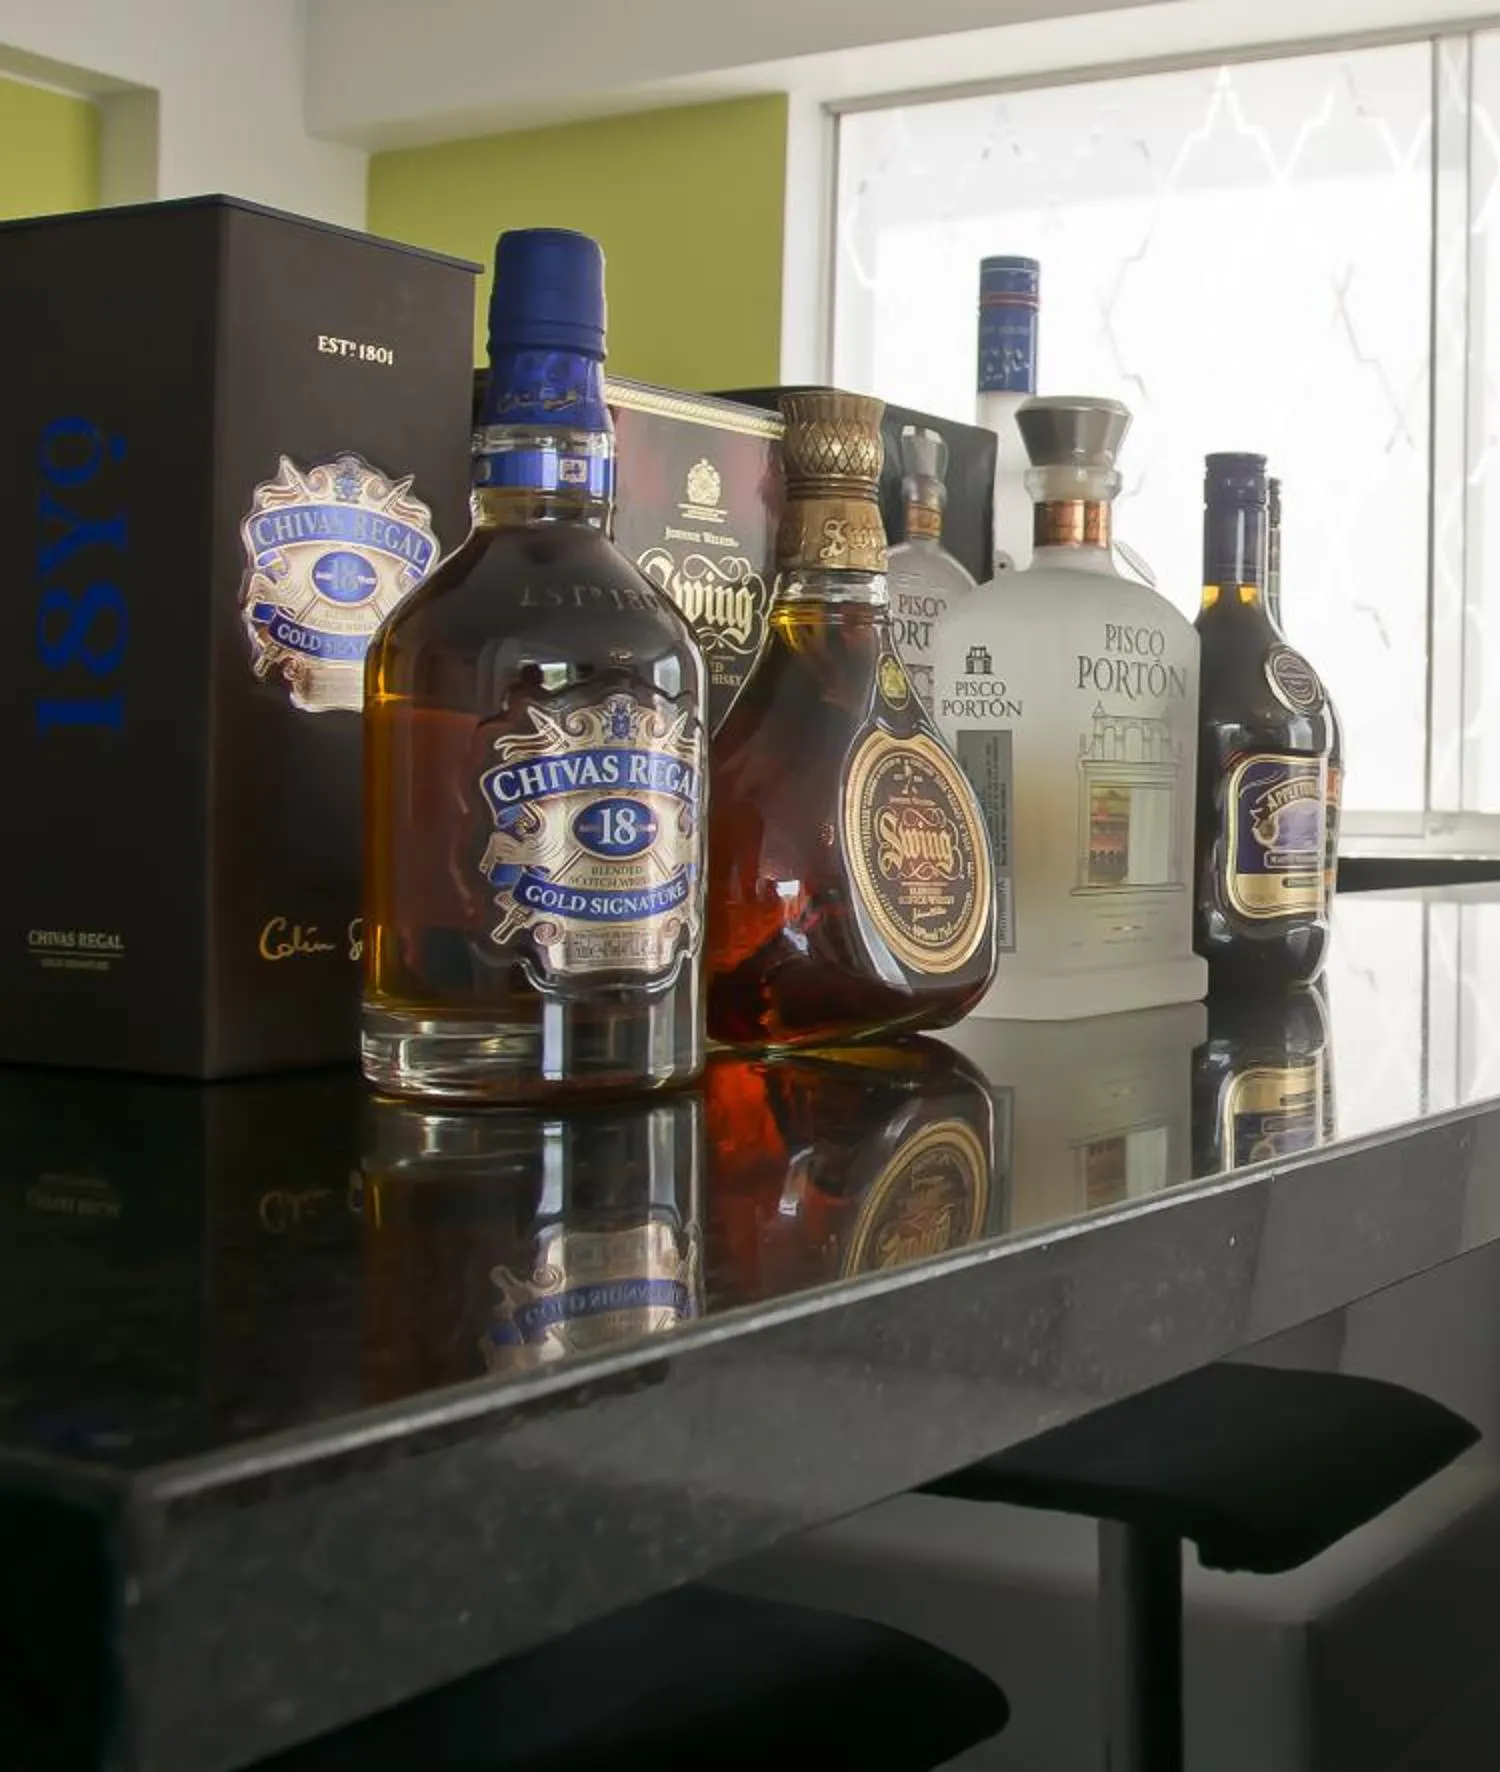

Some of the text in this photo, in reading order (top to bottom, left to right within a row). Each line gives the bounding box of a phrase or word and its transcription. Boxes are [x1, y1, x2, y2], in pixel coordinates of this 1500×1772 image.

[359, 344, 394, 366] 1801
[255, 511, 428, 564] CHIVAS REGAL
[331, 557, 361, 595] 18
[277, 624, 322, 651] GOLD
[1105, 623, 1165, 656] PISCO
[954, 681, 1007, 697] PISCO
[492, 754, 619, 803] CHIVAS
[597, 807, 637, 845] 18
[525, 881, 686, 915] GOLD SIGNATURE
[29, 929, 125, 950] CHIVAS REGAL
